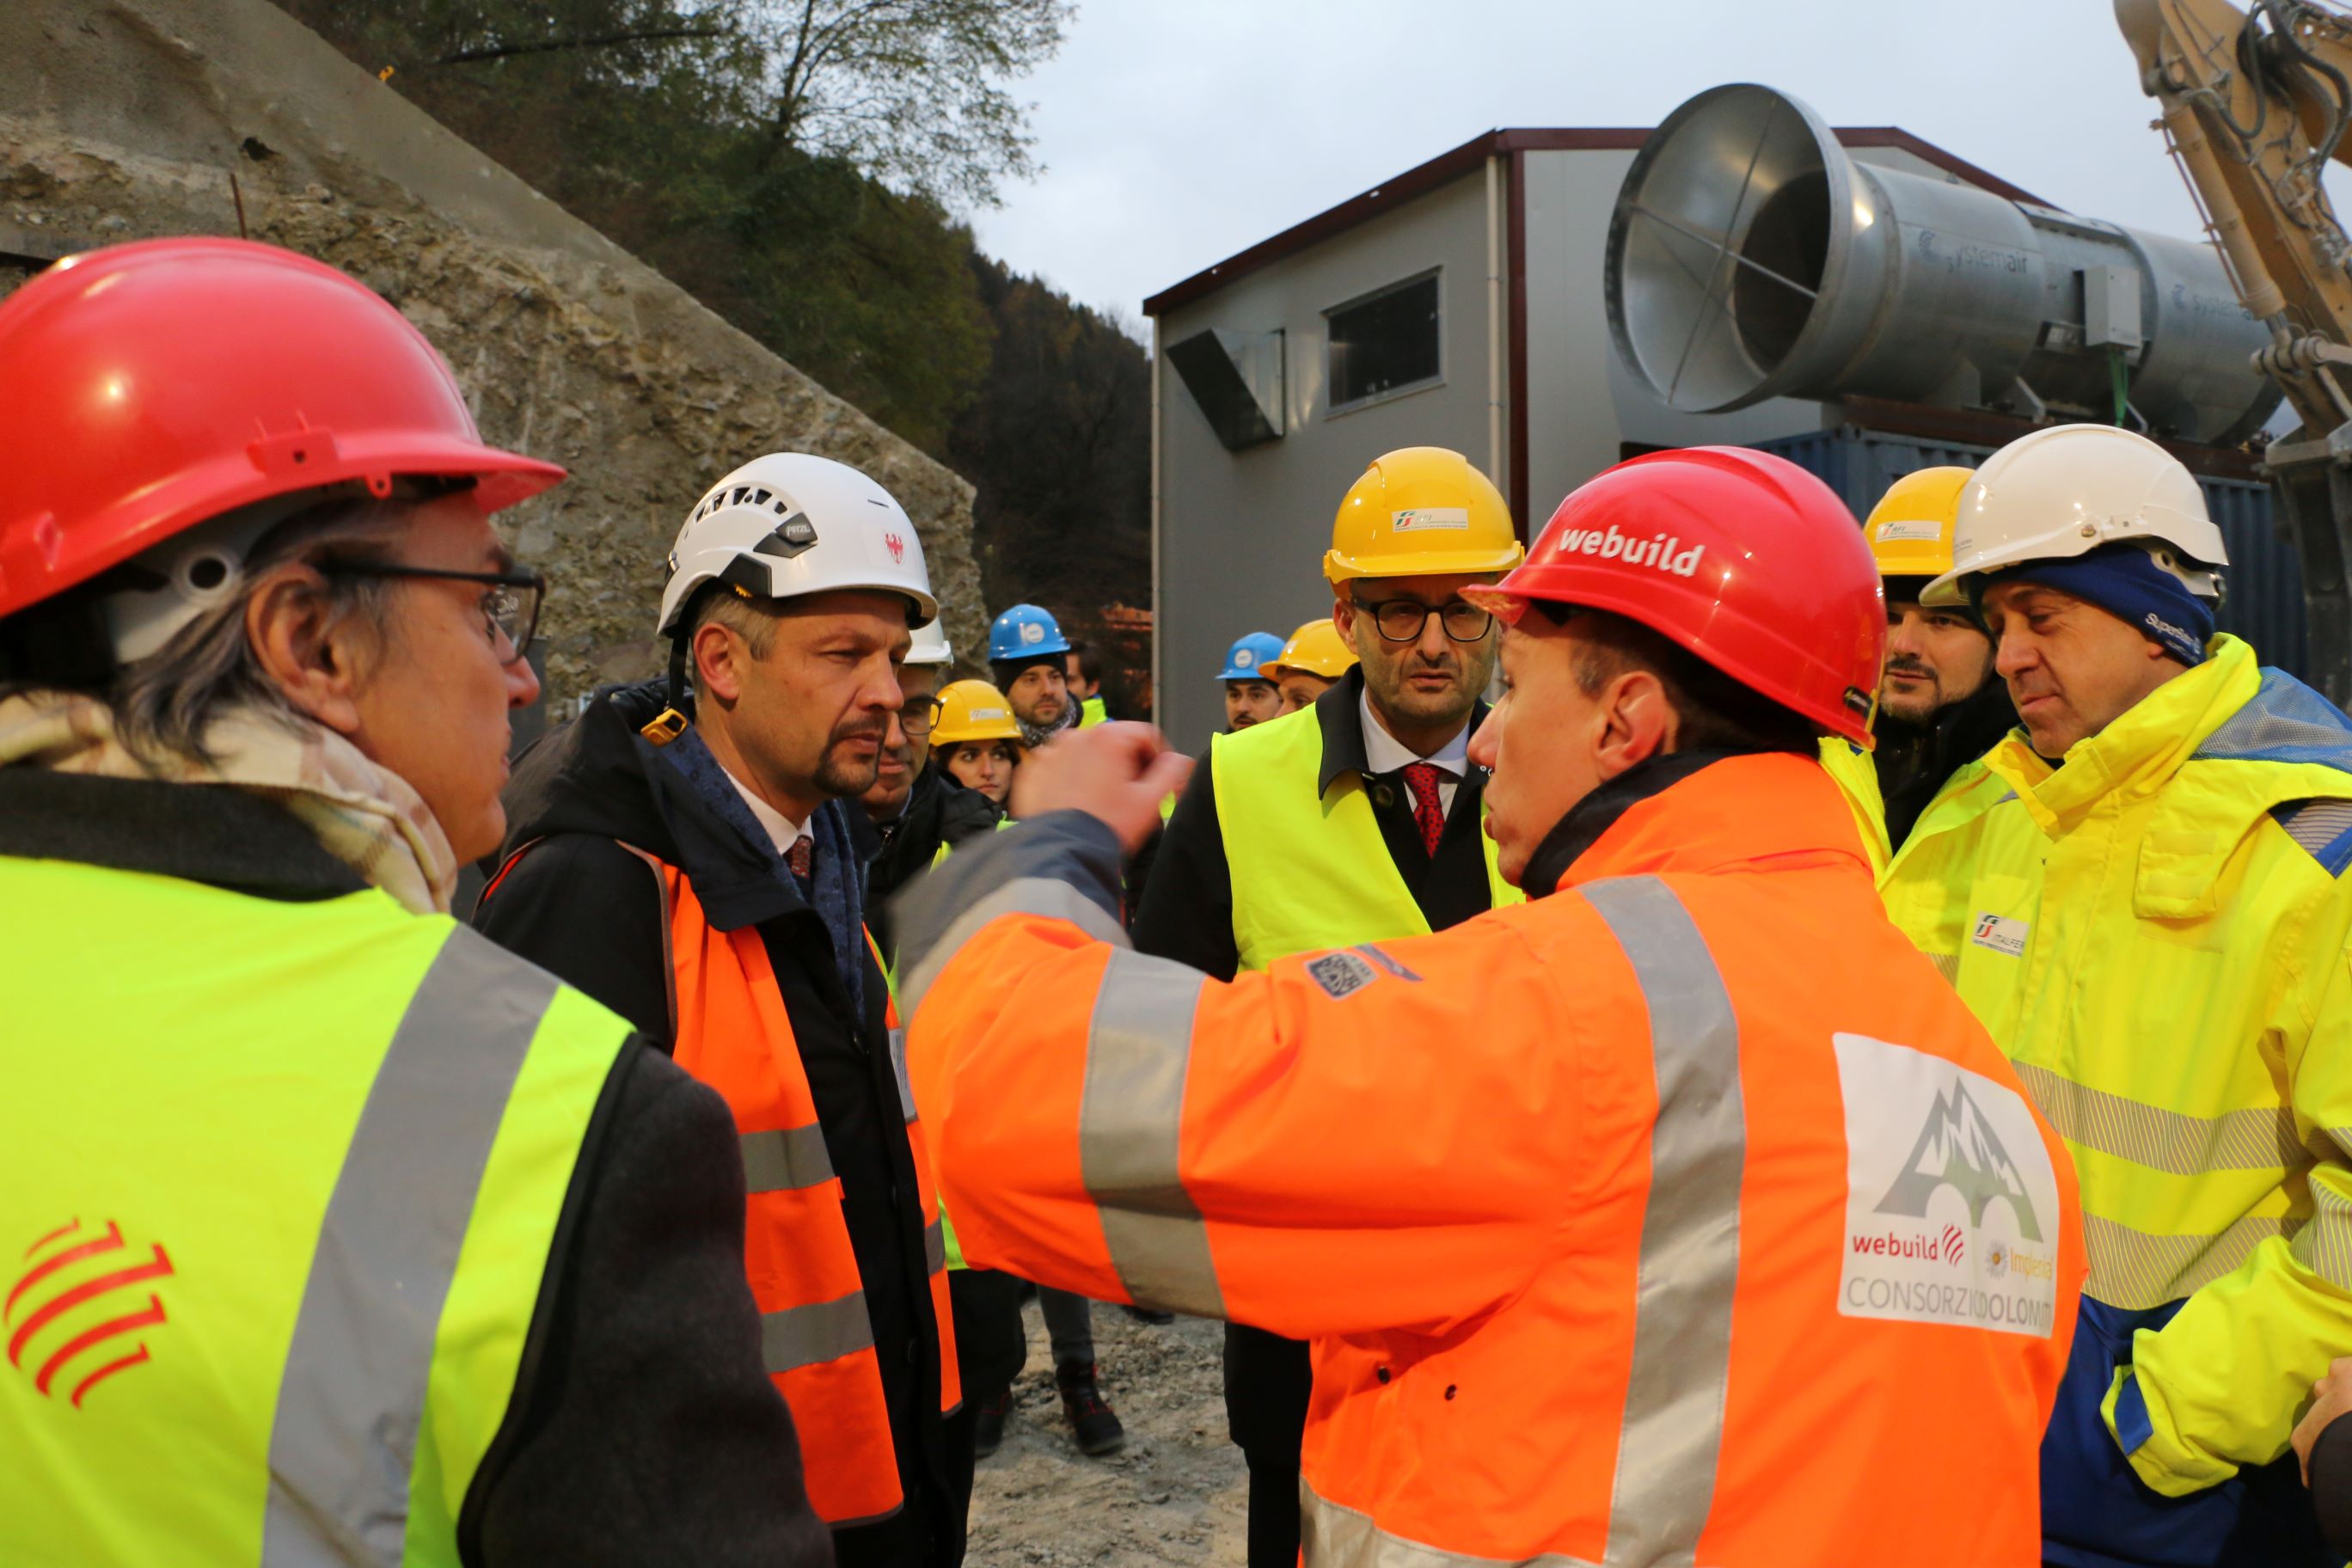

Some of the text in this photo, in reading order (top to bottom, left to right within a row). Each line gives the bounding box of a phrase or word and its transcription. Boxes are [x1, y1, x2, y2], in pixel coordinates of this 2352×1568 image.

[786, 523, 812, 537] PETZL
[1558, 524, 1706, 579] webuild
[1853, 1231, 1939, 1261] webuild
